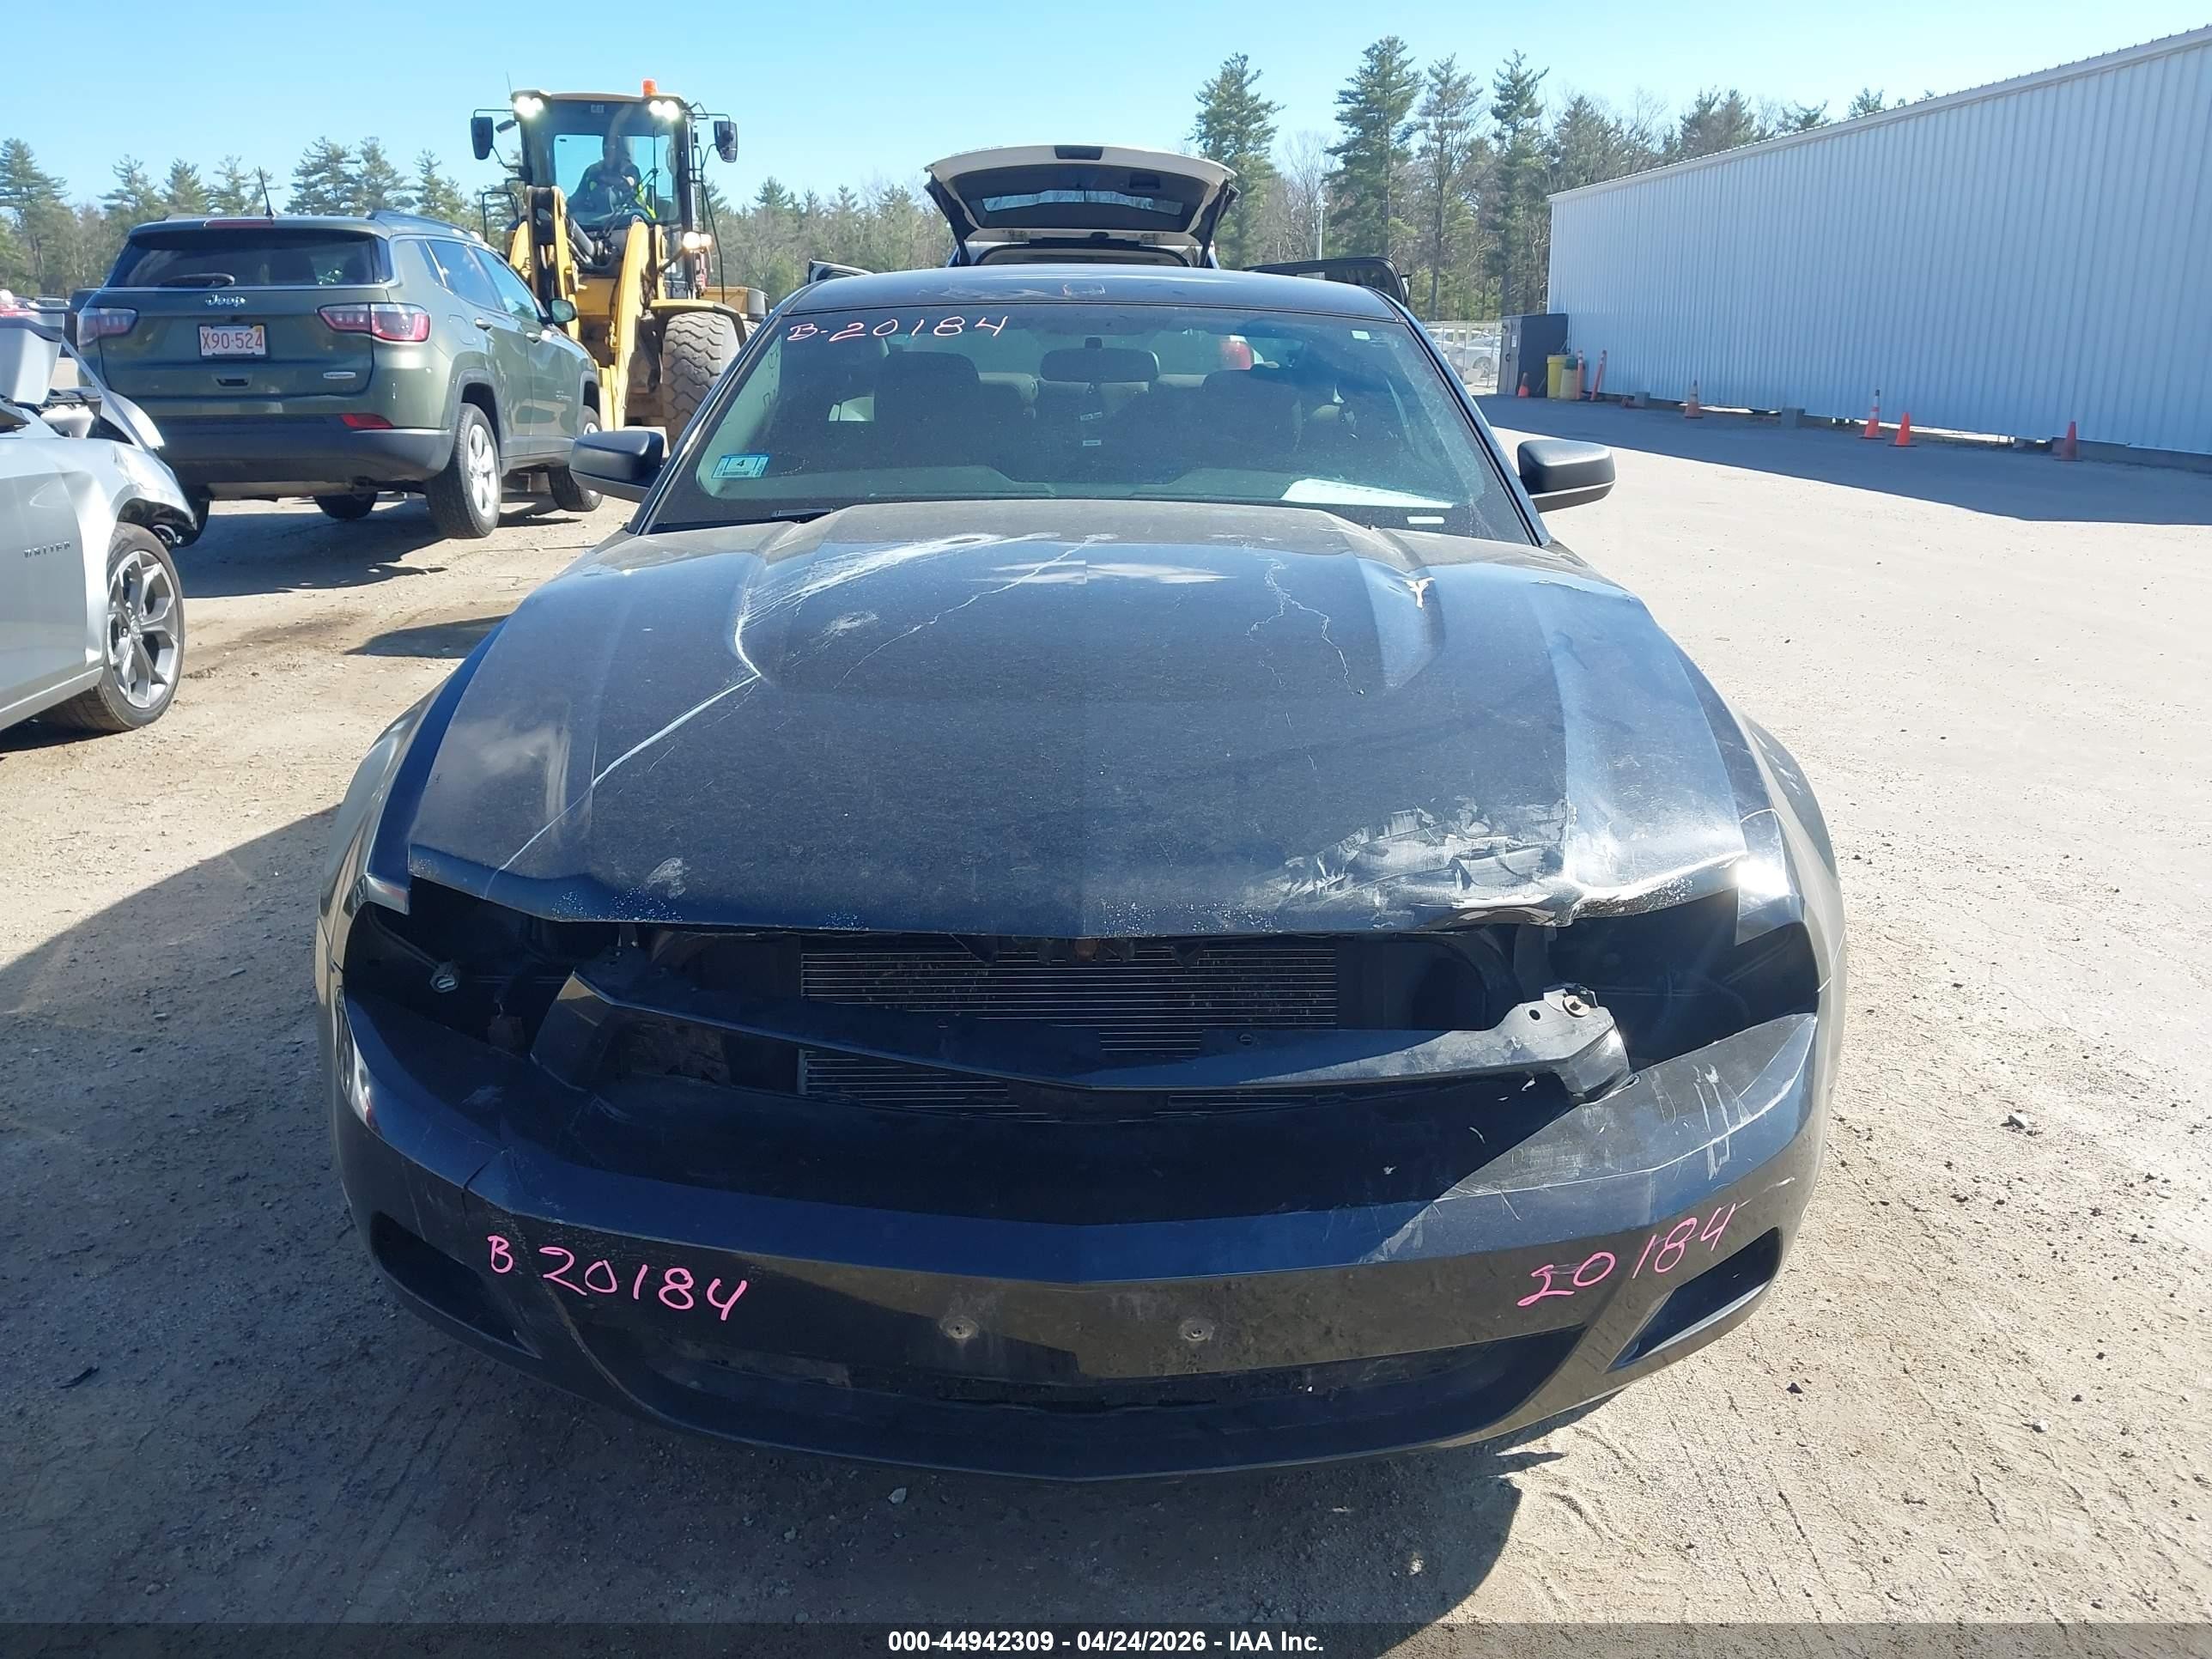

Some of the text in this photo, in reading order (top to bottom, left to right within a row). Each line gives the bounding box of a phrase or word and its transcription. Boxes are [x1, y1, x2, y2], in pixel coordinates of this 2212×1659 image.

[205, 295, 246, 307] Jeep
[487, 1235, 747, 1321] B 20184
[1516, 1202, 1736, 1307] 20184
